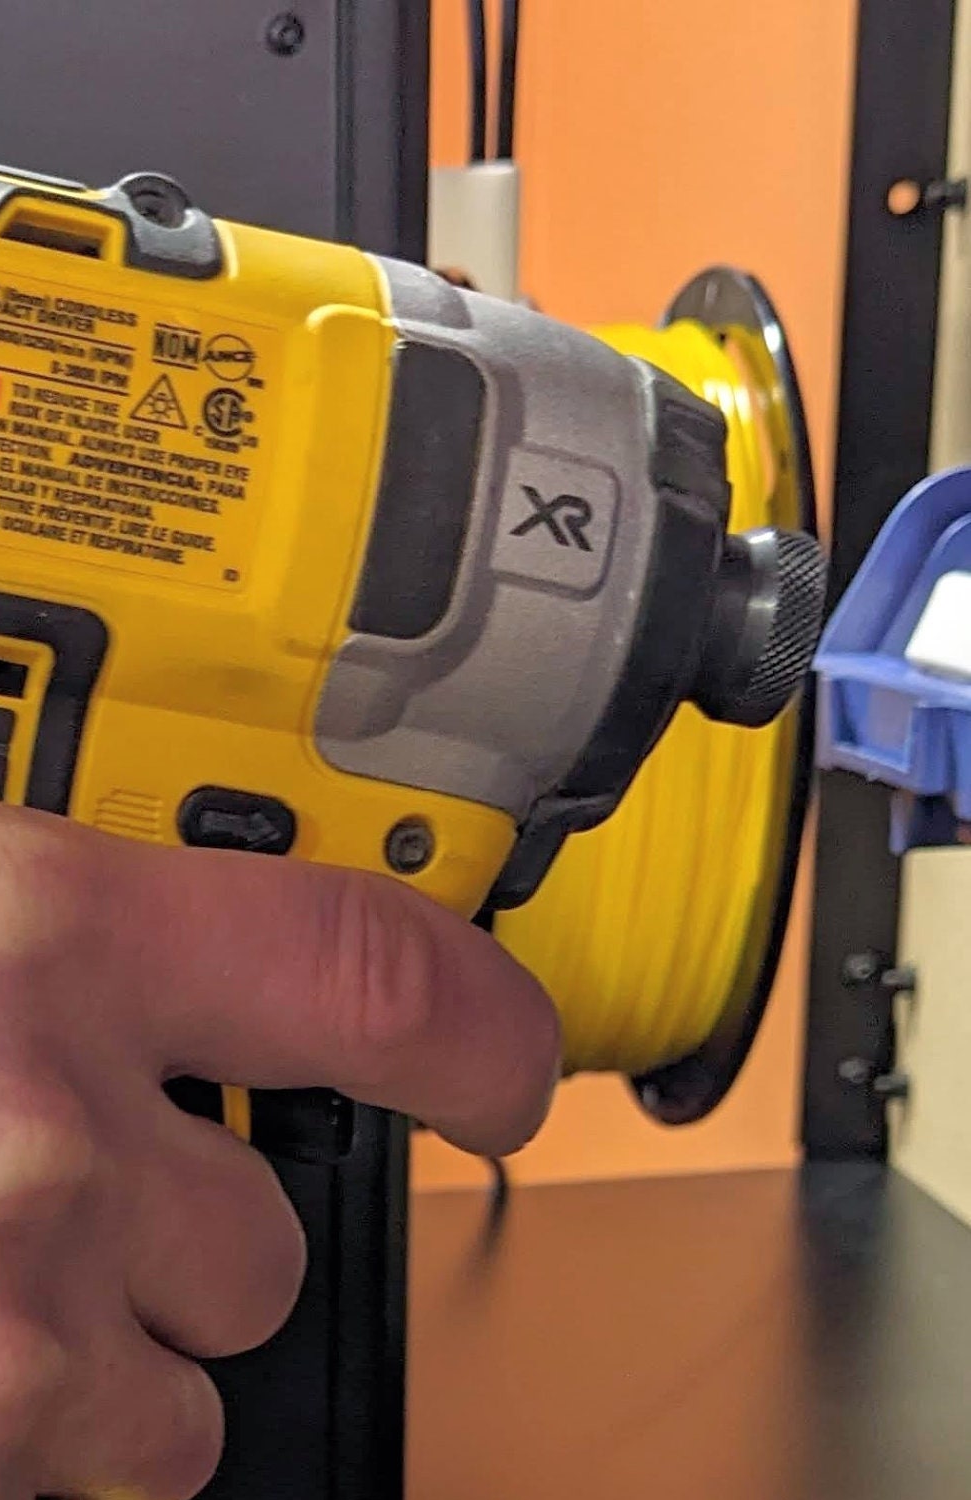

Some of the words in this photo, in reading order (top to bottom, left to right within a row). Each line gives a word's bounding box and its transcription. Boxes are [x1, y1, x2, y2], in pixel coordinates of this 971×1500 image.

[37, 309, 94, 332] DRIVER
[154, 329, 201, 365] NOM
[509, 483, 594, 552] XR
